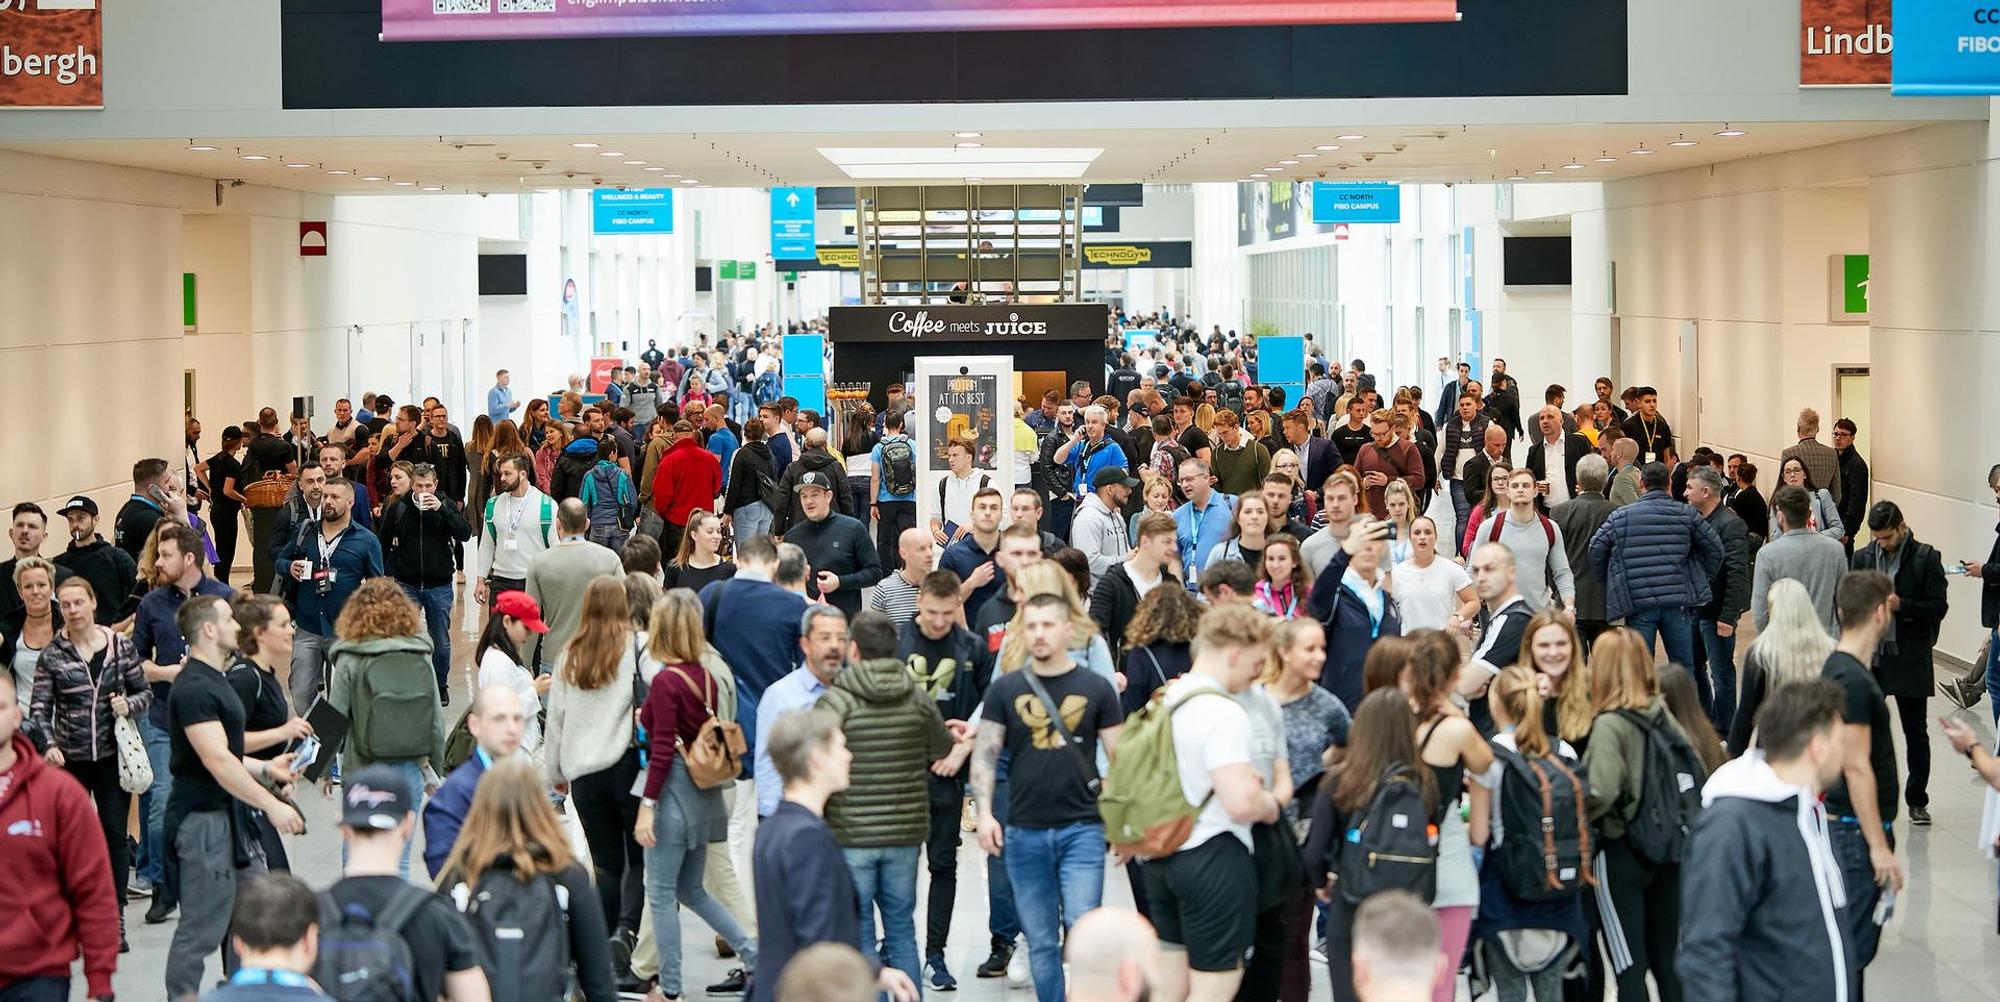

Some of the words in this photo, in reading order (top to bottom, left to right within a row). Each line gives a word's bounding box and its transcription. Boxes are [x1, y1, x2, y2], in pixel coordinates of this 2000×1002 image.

[1974, 9, 2000, 24] CC
[1807, 24, 1894, 55] Lindb
[1957, 36, 2000, 53] FIBO
[4, 45, 97, 85] bergh
[888, 311, 946, 337] Coffee
[950, 320, 980, 333] meets
[947, 379, 977, 391] PROTEIN
[939, 393, 949, 405] AT
[952, 393, 965, 405] ITS
[967, 393, 985, 405] BEST
